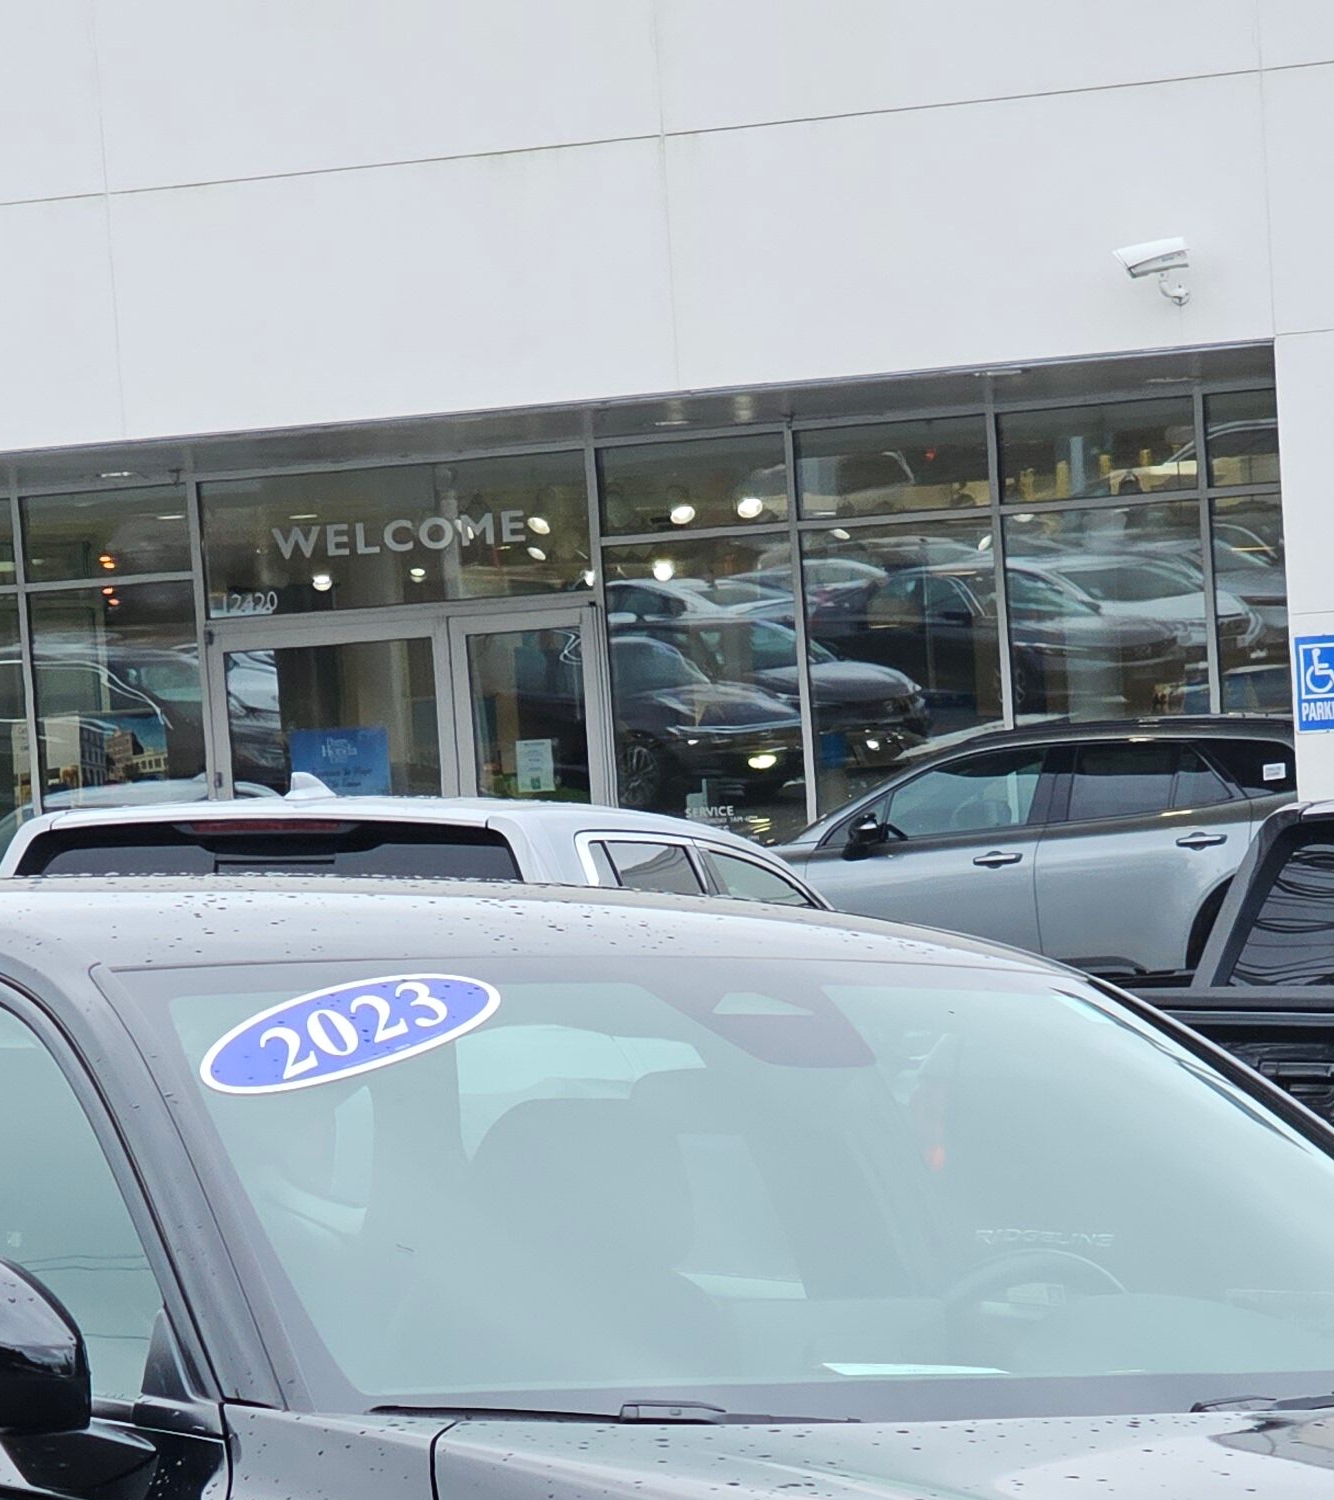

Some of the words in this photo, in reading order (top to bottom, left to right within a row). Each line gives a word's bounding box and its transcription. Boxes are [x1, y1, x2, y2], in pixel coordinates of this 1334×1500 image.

[272, 510, 526, 560] WELCOME
[221, 591, 278, 614] 12420
[685, 805, 735, 818] SERVICE
[260, 981, 449, 1080] 2023
